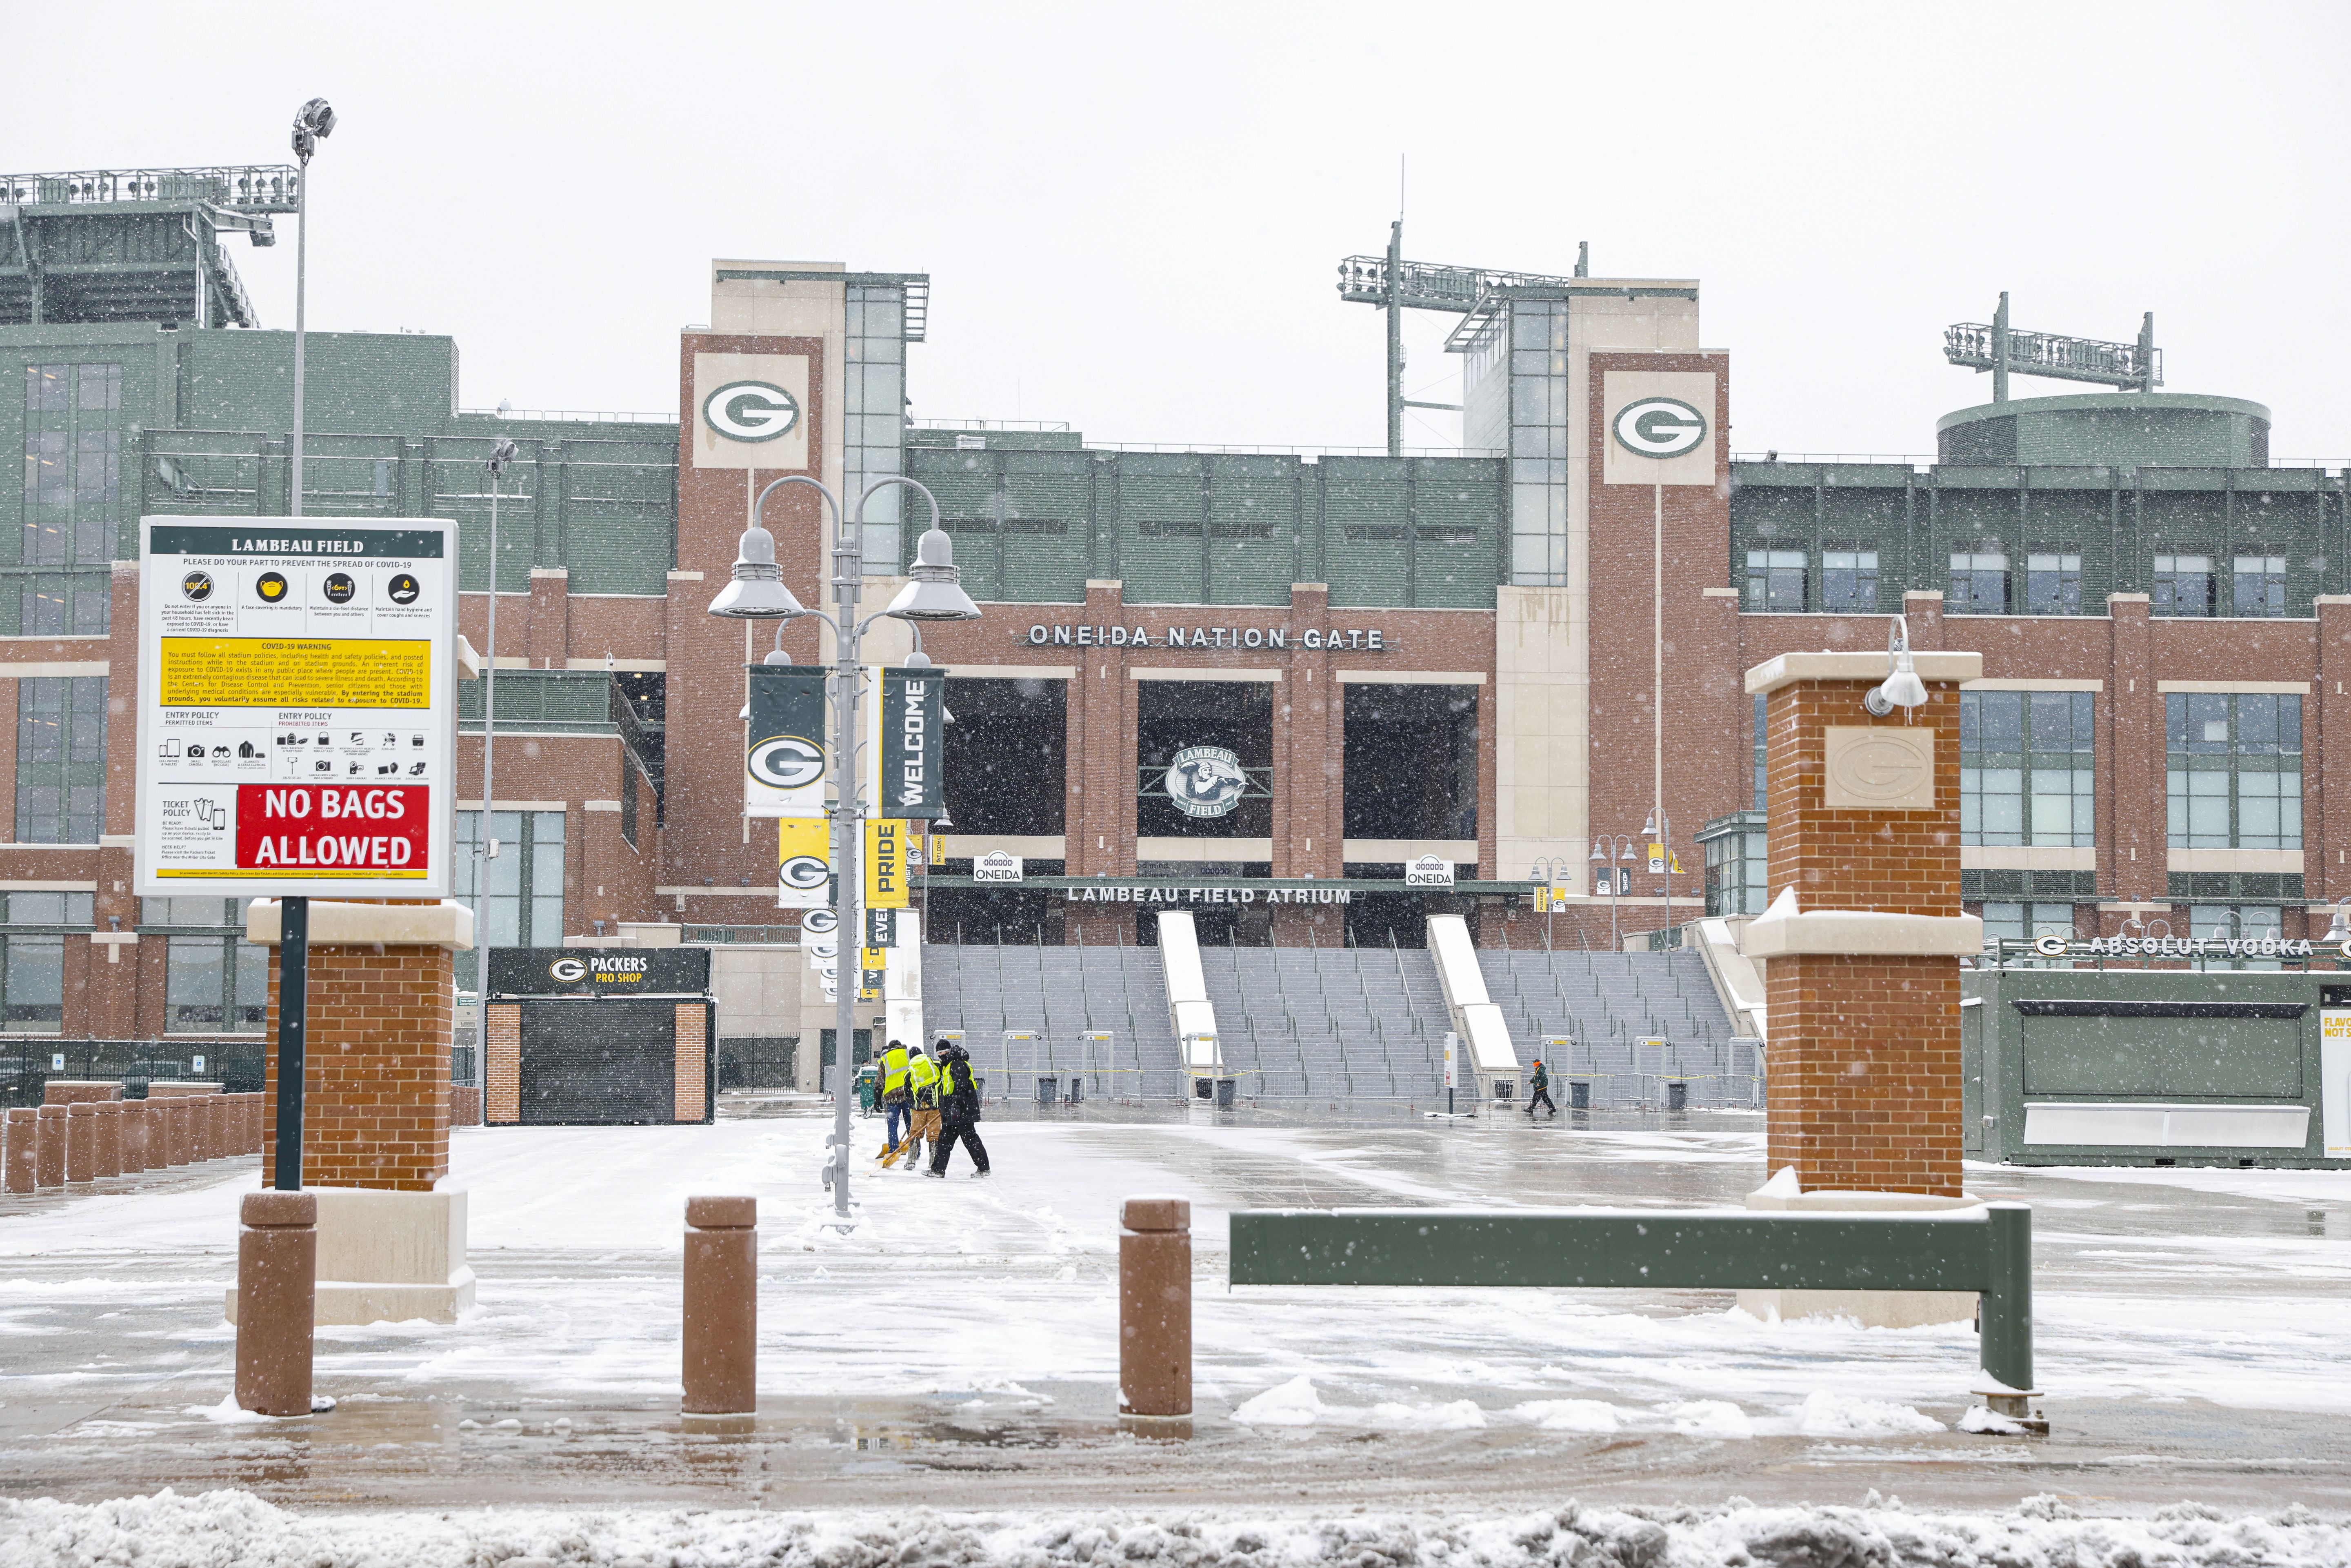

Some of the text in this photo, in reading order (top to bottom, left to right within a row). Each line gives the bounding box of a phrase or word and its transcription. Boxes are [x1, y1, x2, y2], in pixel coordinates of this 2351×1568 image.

[232, 539, 363, 552] LAMBEAU FIELD
[1029, 624, 1384, 650] ONEIDA NATION GATE
[904, 680, 924, 806] WELCOME
[1179, 748, 1232, 763] LAMBEAU
[266, 788, 404, 819] NO BAGS
[1189, 805, 1222, 815] FIELD
[255, 836, 411, 864] ALLOWED
[878, 824, 894, 892] PRIDE
[976, 870, 1020, 880] ONEIDA
[1408, 873, 1452, 884] ONEIDA
[1068, 887, 1350, 904] LAMBEAU FIELD ATRIUM
[2090, 937, 2209, 955] ABSOLUT
[2225, 938, 2314, 955] VODKA
[591, 957, 647, 971] PACKERS
[596, 973, 642, 982] PRO SHOP
[2324, 1017, 2351, 1027] FLAVO
[2325, 1028, 2343, 1037] NOT
